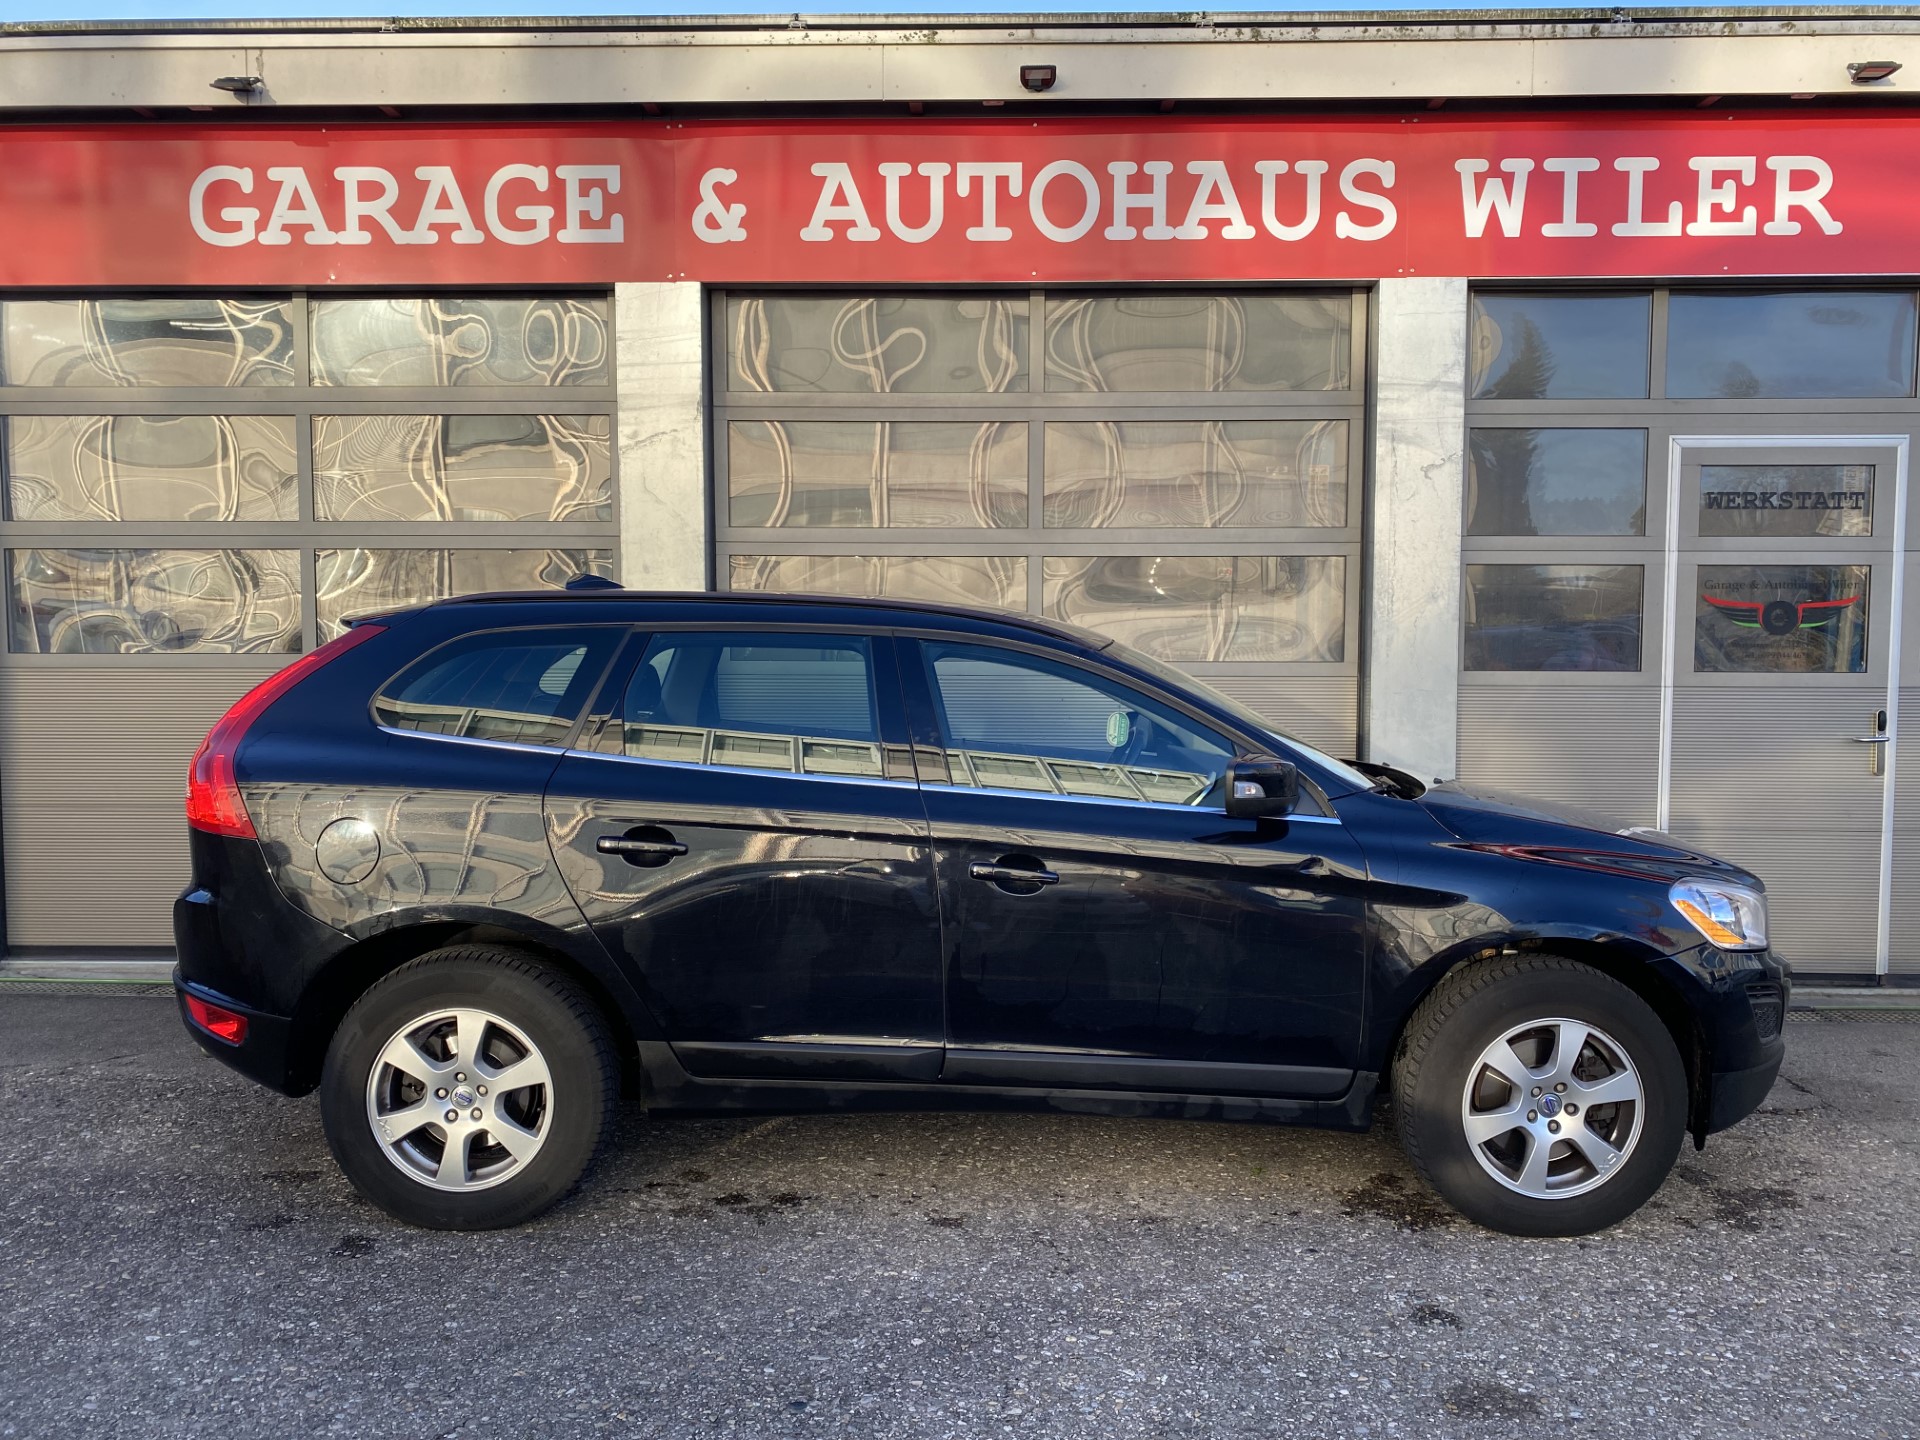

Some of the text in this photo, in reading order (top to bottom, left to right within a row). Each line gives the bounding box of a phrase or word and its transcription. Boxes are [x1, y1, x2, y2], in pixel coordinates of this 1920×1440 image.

[189, 155, 1844, 248] GARAGE & AUTOHAUS WILER
[1703, 491, 1865, 510] WERKSTATT
[1704, 579, 1746, 592] Garage
[1750, 580, 1759, 590] &
[1765, 579, 1816, 590] Autoha
